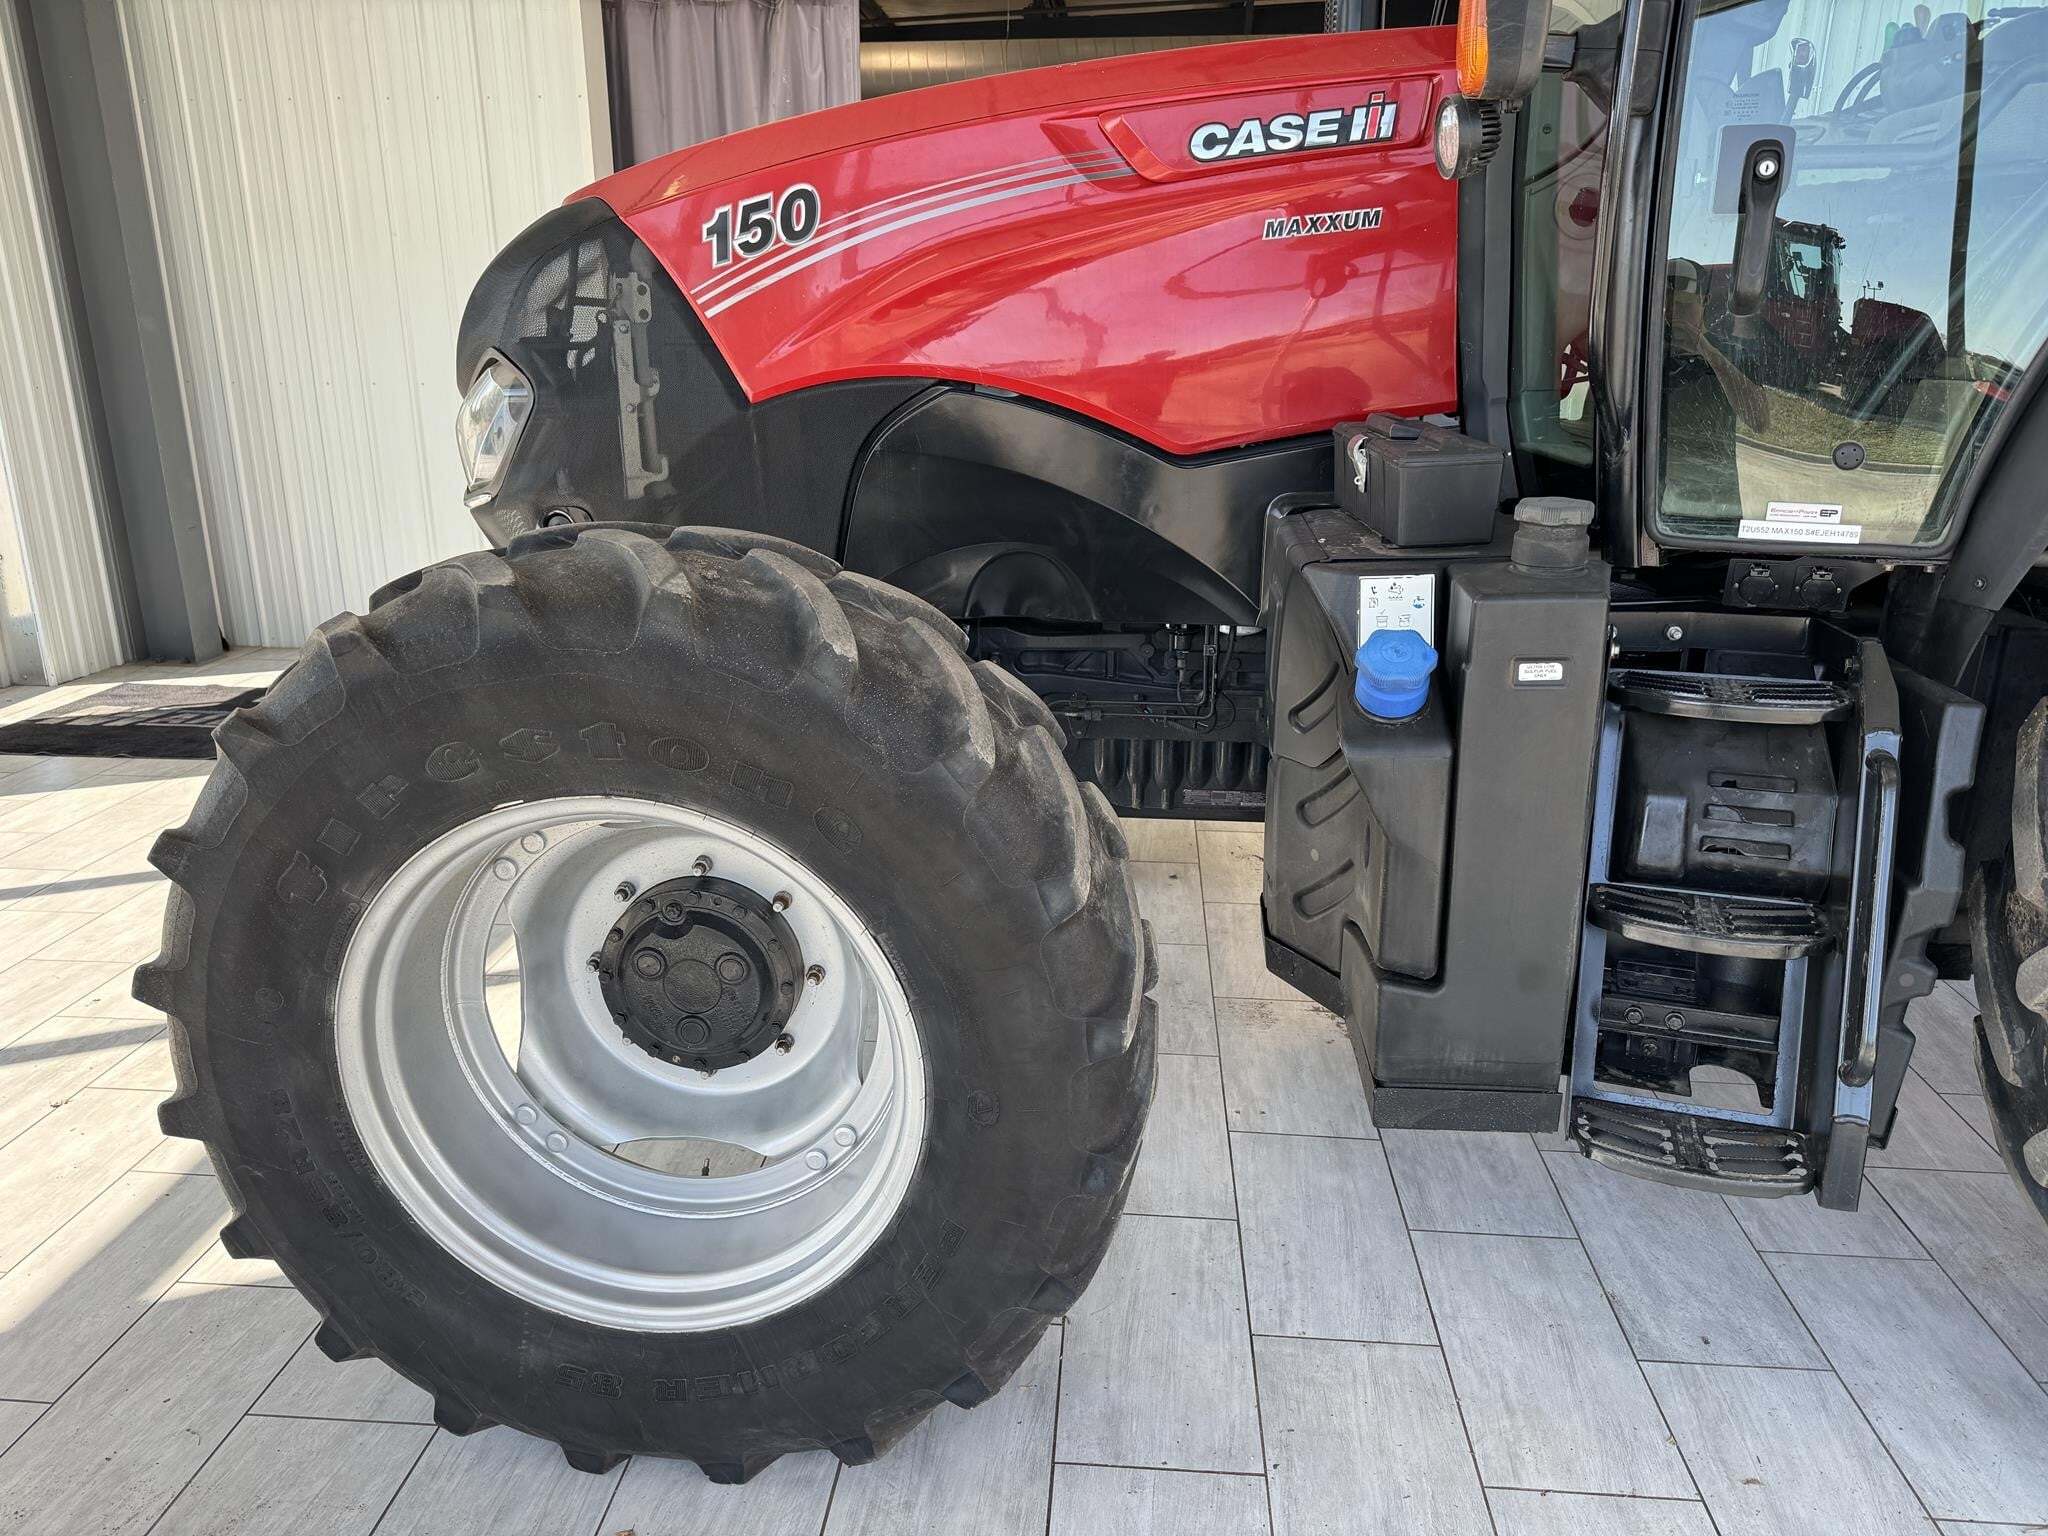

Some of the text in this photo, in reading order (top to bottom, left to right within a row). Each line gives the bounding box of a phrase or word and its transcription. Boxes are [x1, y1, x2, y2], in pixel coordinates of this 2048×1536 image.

[1190, 109, 1342, 161] CASE
[702, 182, 821, 269] 150
[1262, 207, 1383, 240] MAXXUM
[554, 1217, 968, 1402] PERFORMER 85
